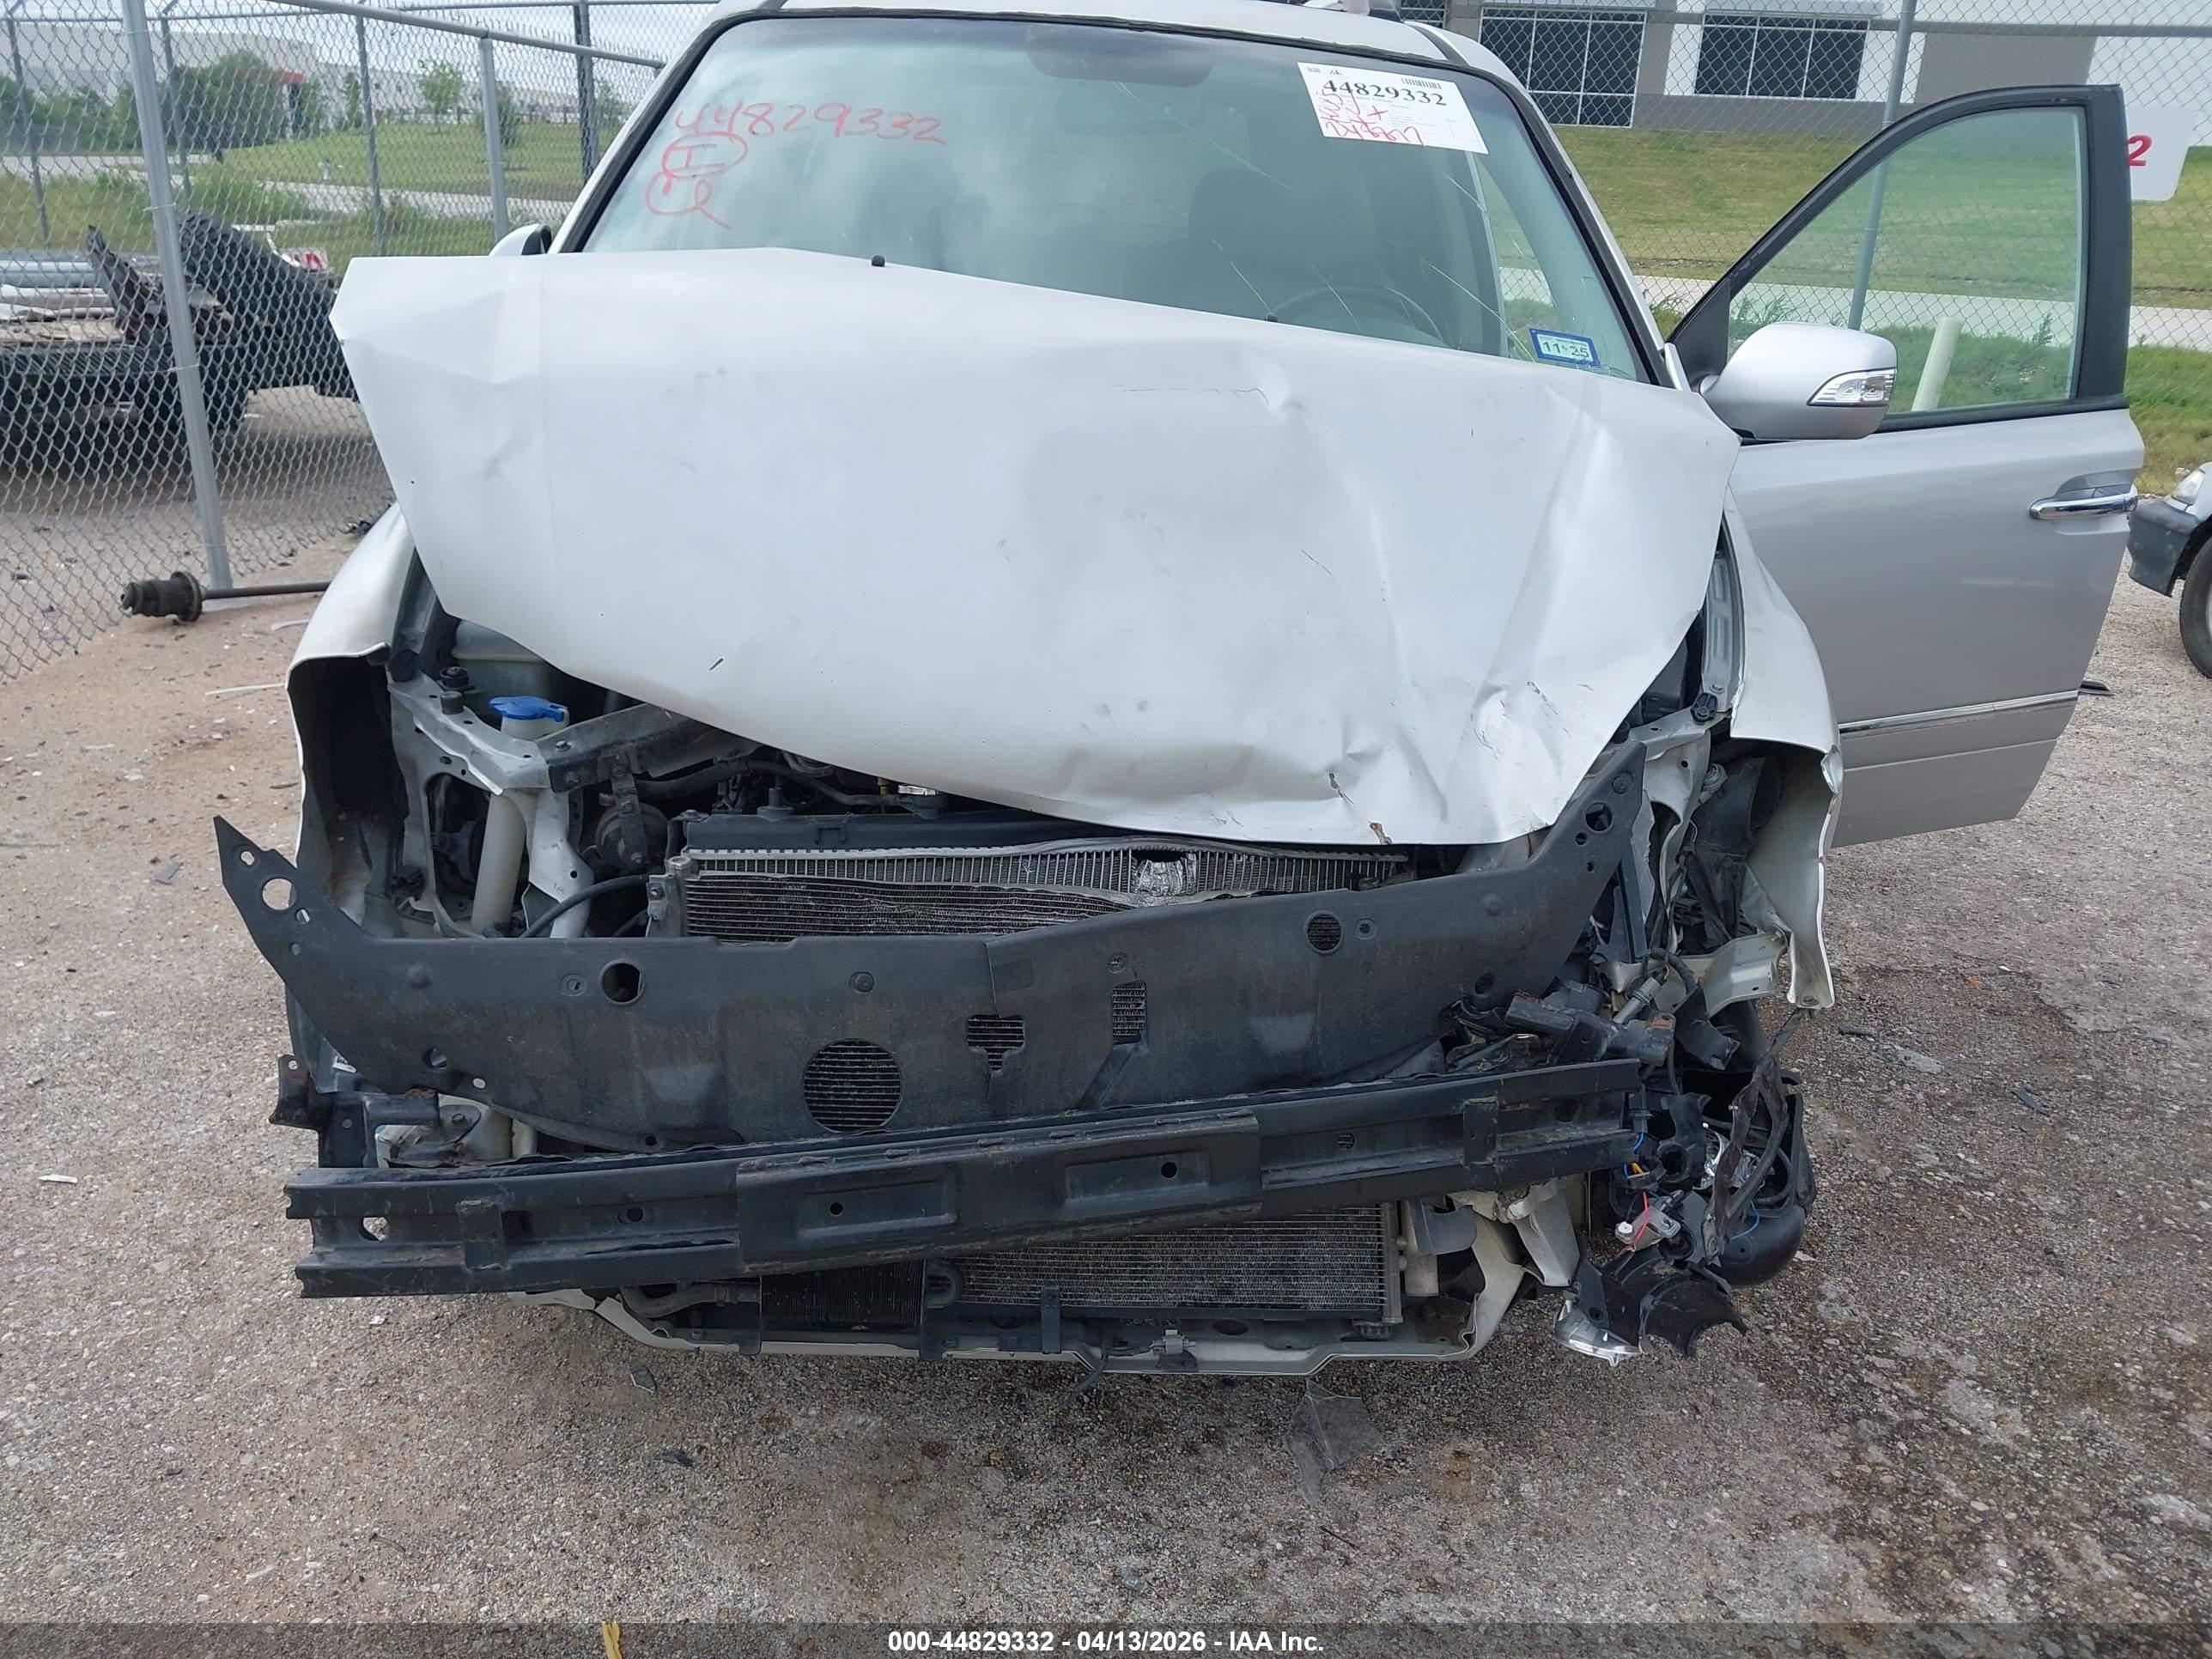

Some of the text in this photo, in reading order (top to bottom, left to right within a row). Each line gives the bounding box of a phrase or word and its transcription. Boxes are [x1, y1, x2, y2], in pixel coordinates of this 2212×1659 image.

[1322, 80, 1447, 106] 44829332
[674, 100, 947, 146] 44829332
[2126, 134, 2153, 167] 2
